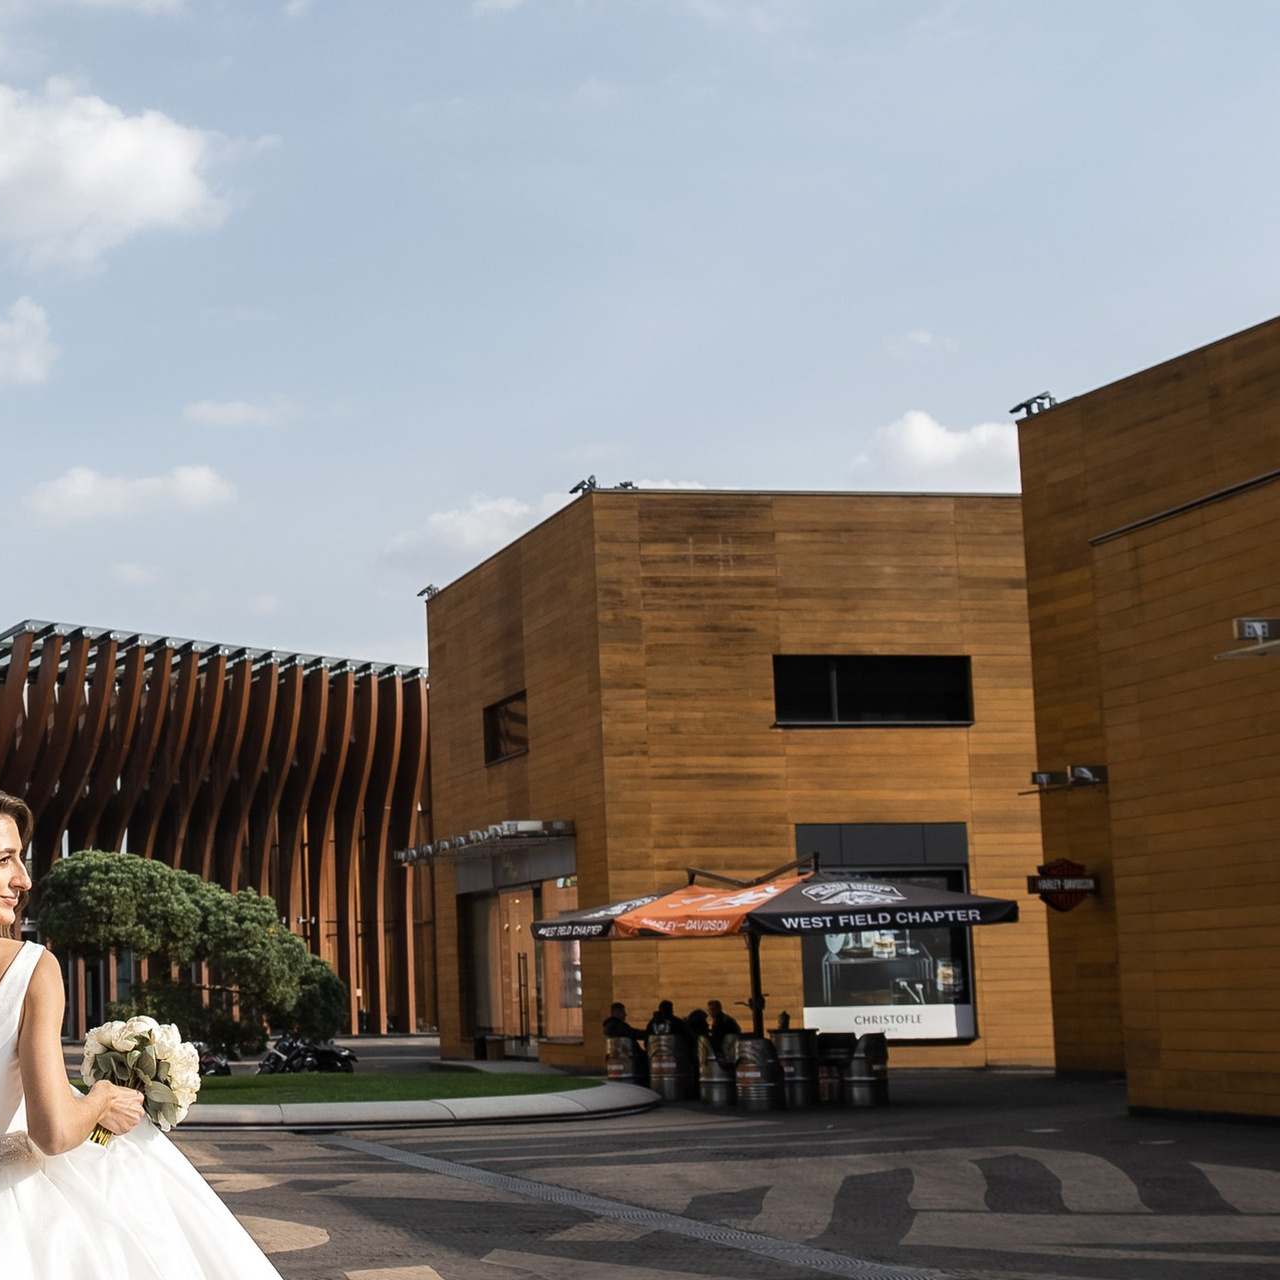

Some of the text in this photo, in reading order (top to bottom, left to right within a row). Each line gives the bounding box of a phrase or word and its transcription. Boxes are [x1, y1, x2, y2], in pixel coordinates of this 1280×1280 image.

[781, 909, 981, 930] WEST FIELD CHAPTER
[854, 1014, 923, 1025] CHRISTOFLE
